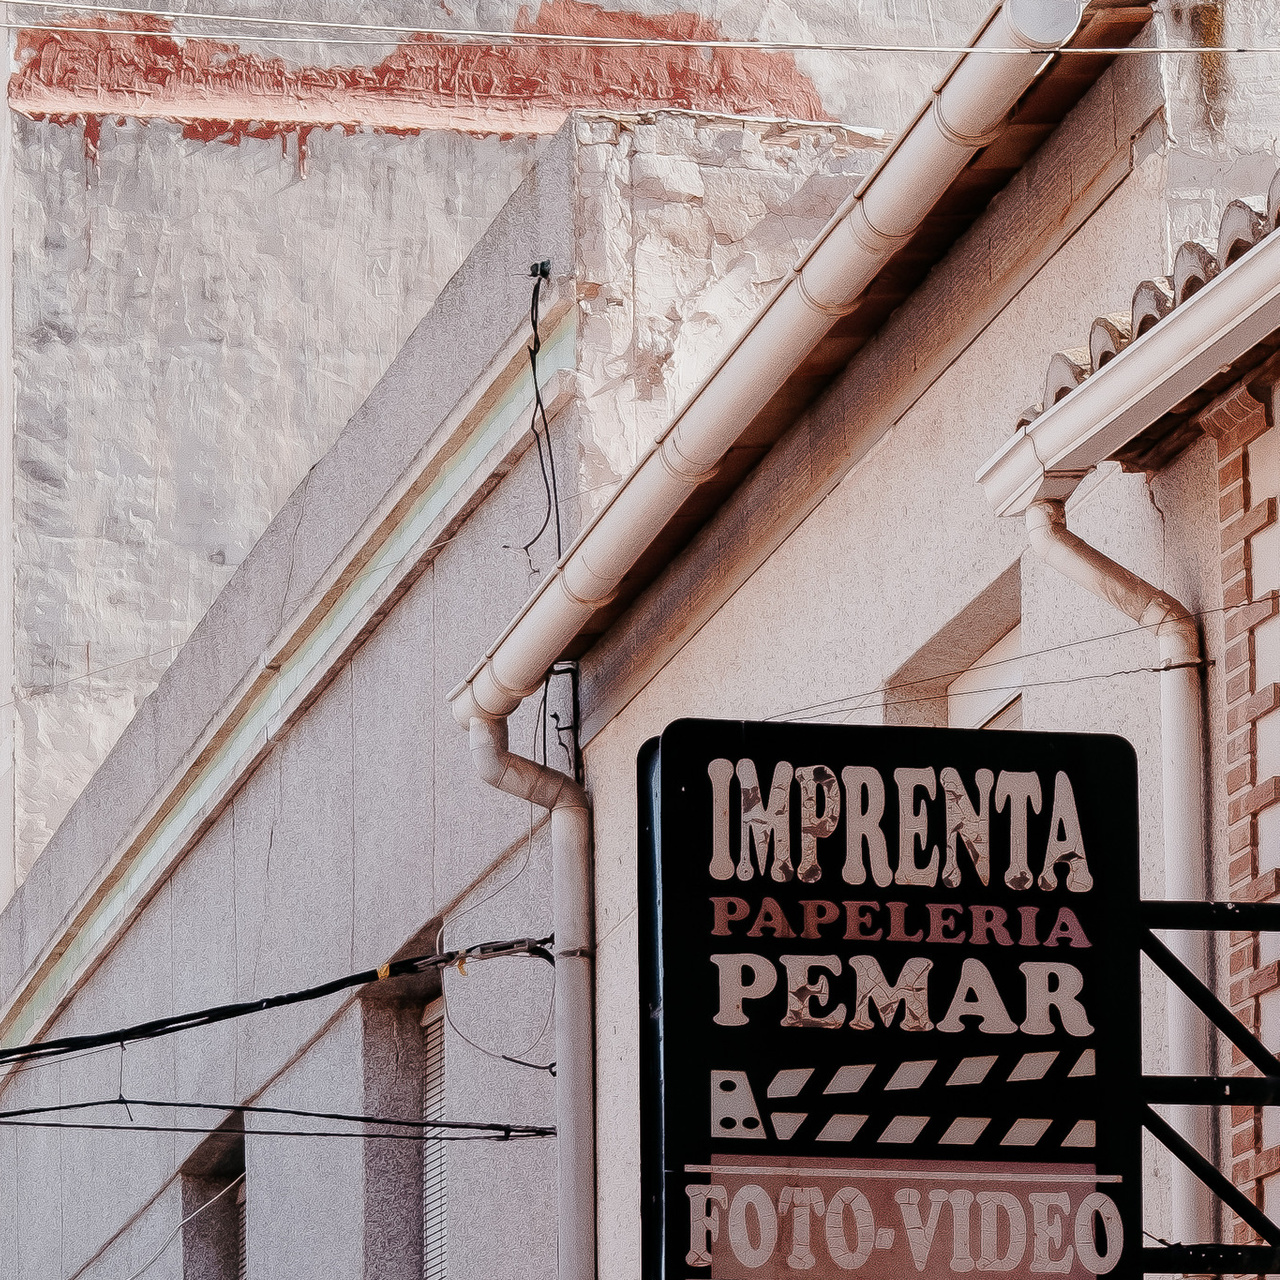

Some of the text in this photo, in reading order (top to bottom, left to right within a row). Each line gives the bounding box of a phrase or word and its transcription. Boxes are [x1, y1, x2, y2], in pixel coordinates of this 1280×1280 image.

[708, 758, 1093, 891] IMPRENTA
[709, 896, 1092, 948] PAPELERIA
[710, 953, 1095, 1036] PEMAR
[685, 1184, 1124, 1274] FOTO-VIDEO
